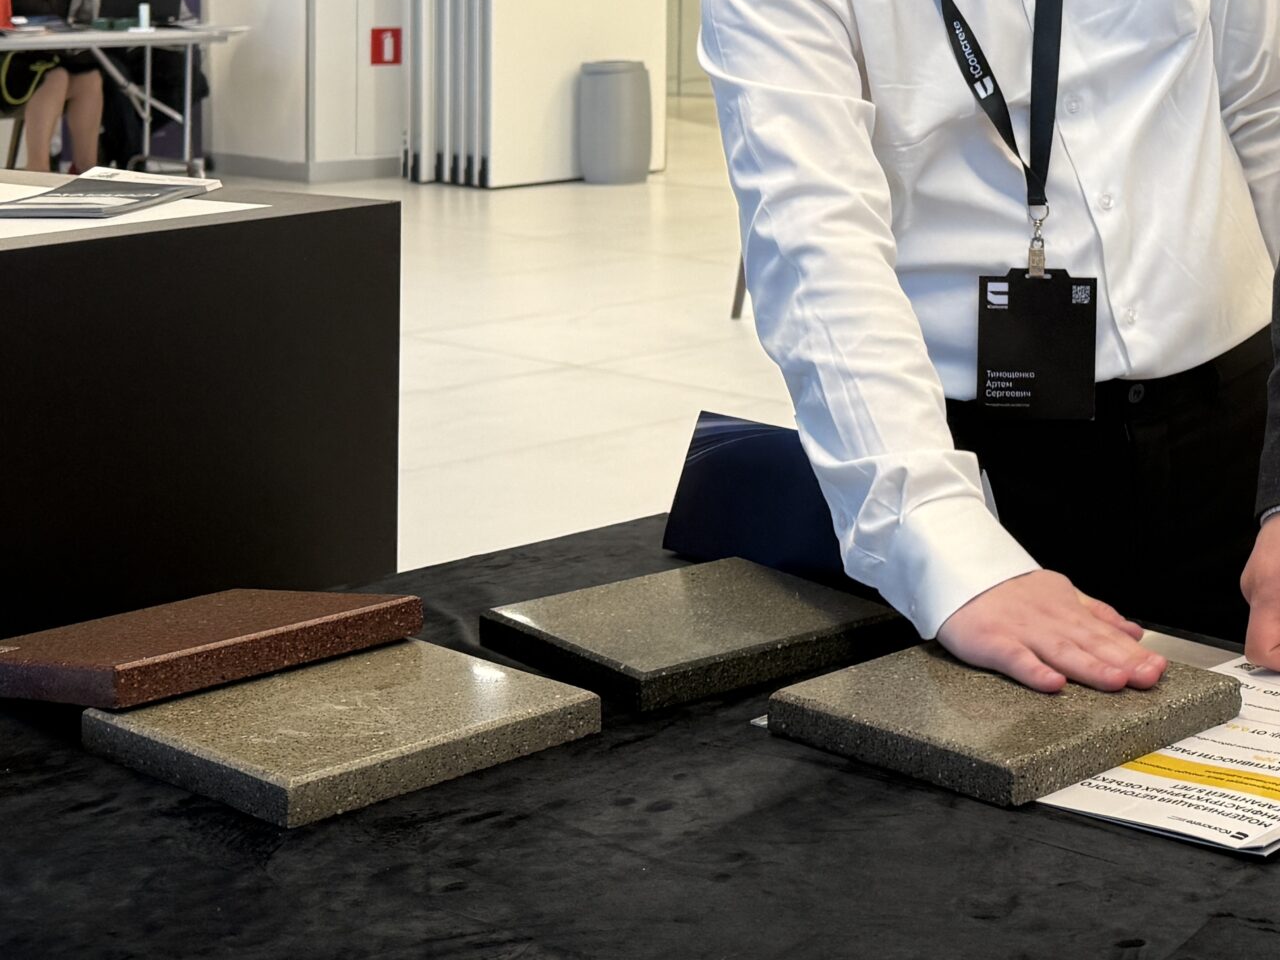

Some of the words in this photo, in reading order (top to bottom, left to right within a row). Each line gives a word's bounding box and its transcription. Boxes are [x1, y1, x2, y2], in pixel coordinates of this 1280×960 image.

[1162, 743, 1197, 755] РАБО
[1079, 778, 1157, 800] БЕТОННОГО
[1089, 773, 1142, 789] ОБЪЕКТ
[1157, 796, 1278, 827] МОДЕРНИЗАЦИЯ
